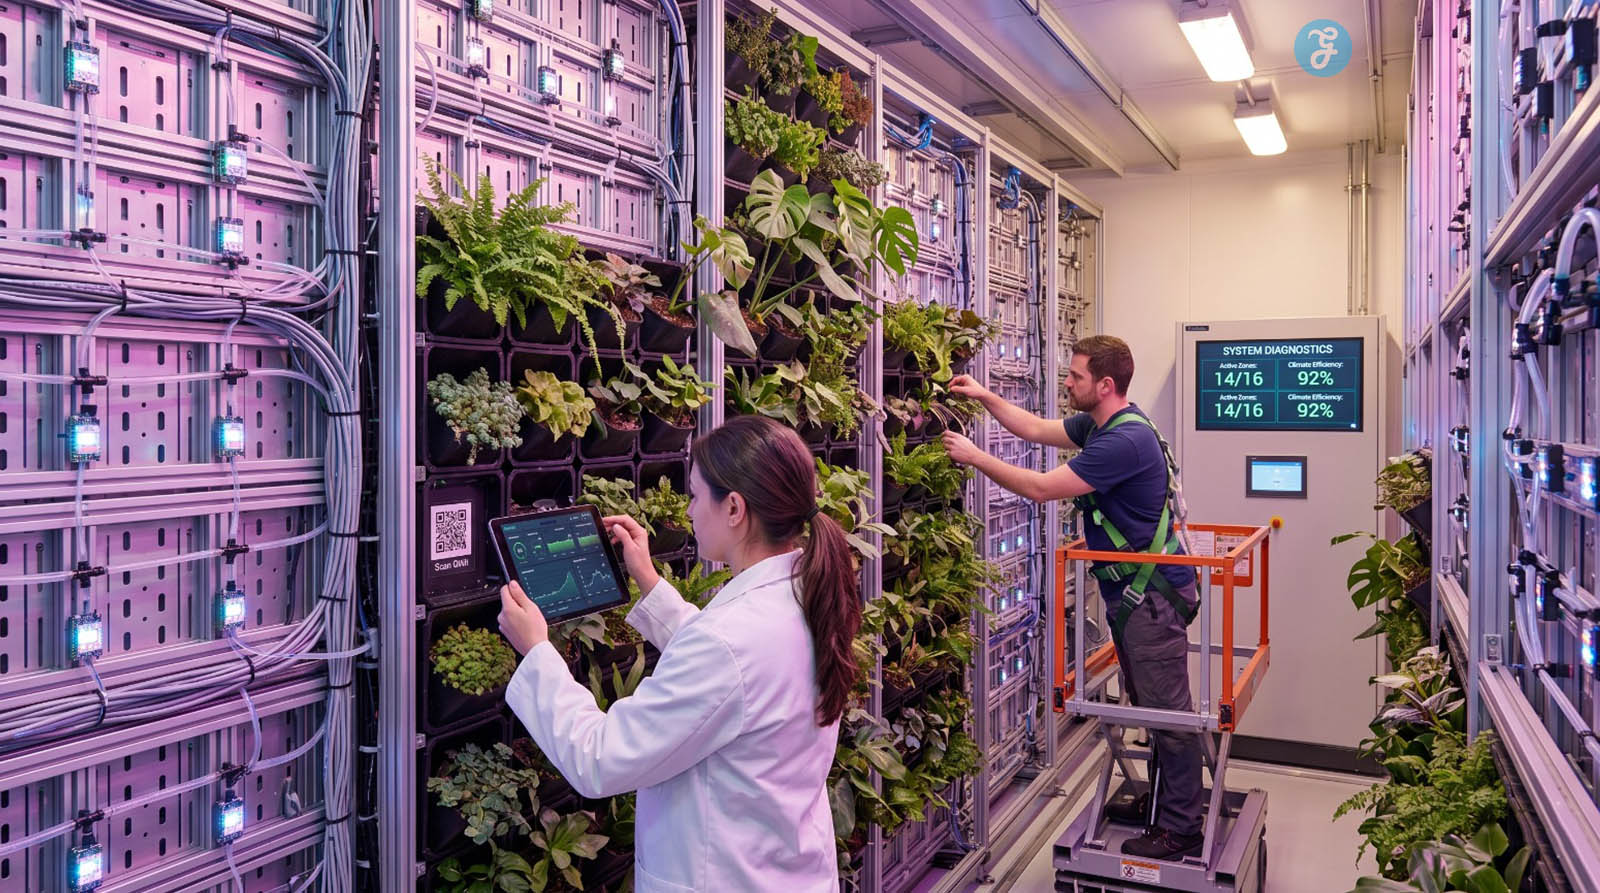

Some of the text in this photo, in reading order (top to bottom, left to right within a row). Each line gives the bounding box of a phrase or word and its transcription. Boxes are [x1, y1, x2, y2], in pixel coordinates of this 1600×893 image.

[1223, 344, 1333, 356] SYSTEM DIAGNOSTICS
[1312, 361, 1344, 369] Efficiency:
[1214, 371, 1264, 388] 14/16
[1297, 370, 1334, 386] 92%
[1287, 393, 1344, 402] Climate Efficiency:
[1214, 402, 1264, 419] 14/16
[1297, 402, 1334, 418] 92%
[434, 562, 452, 572] Scan
